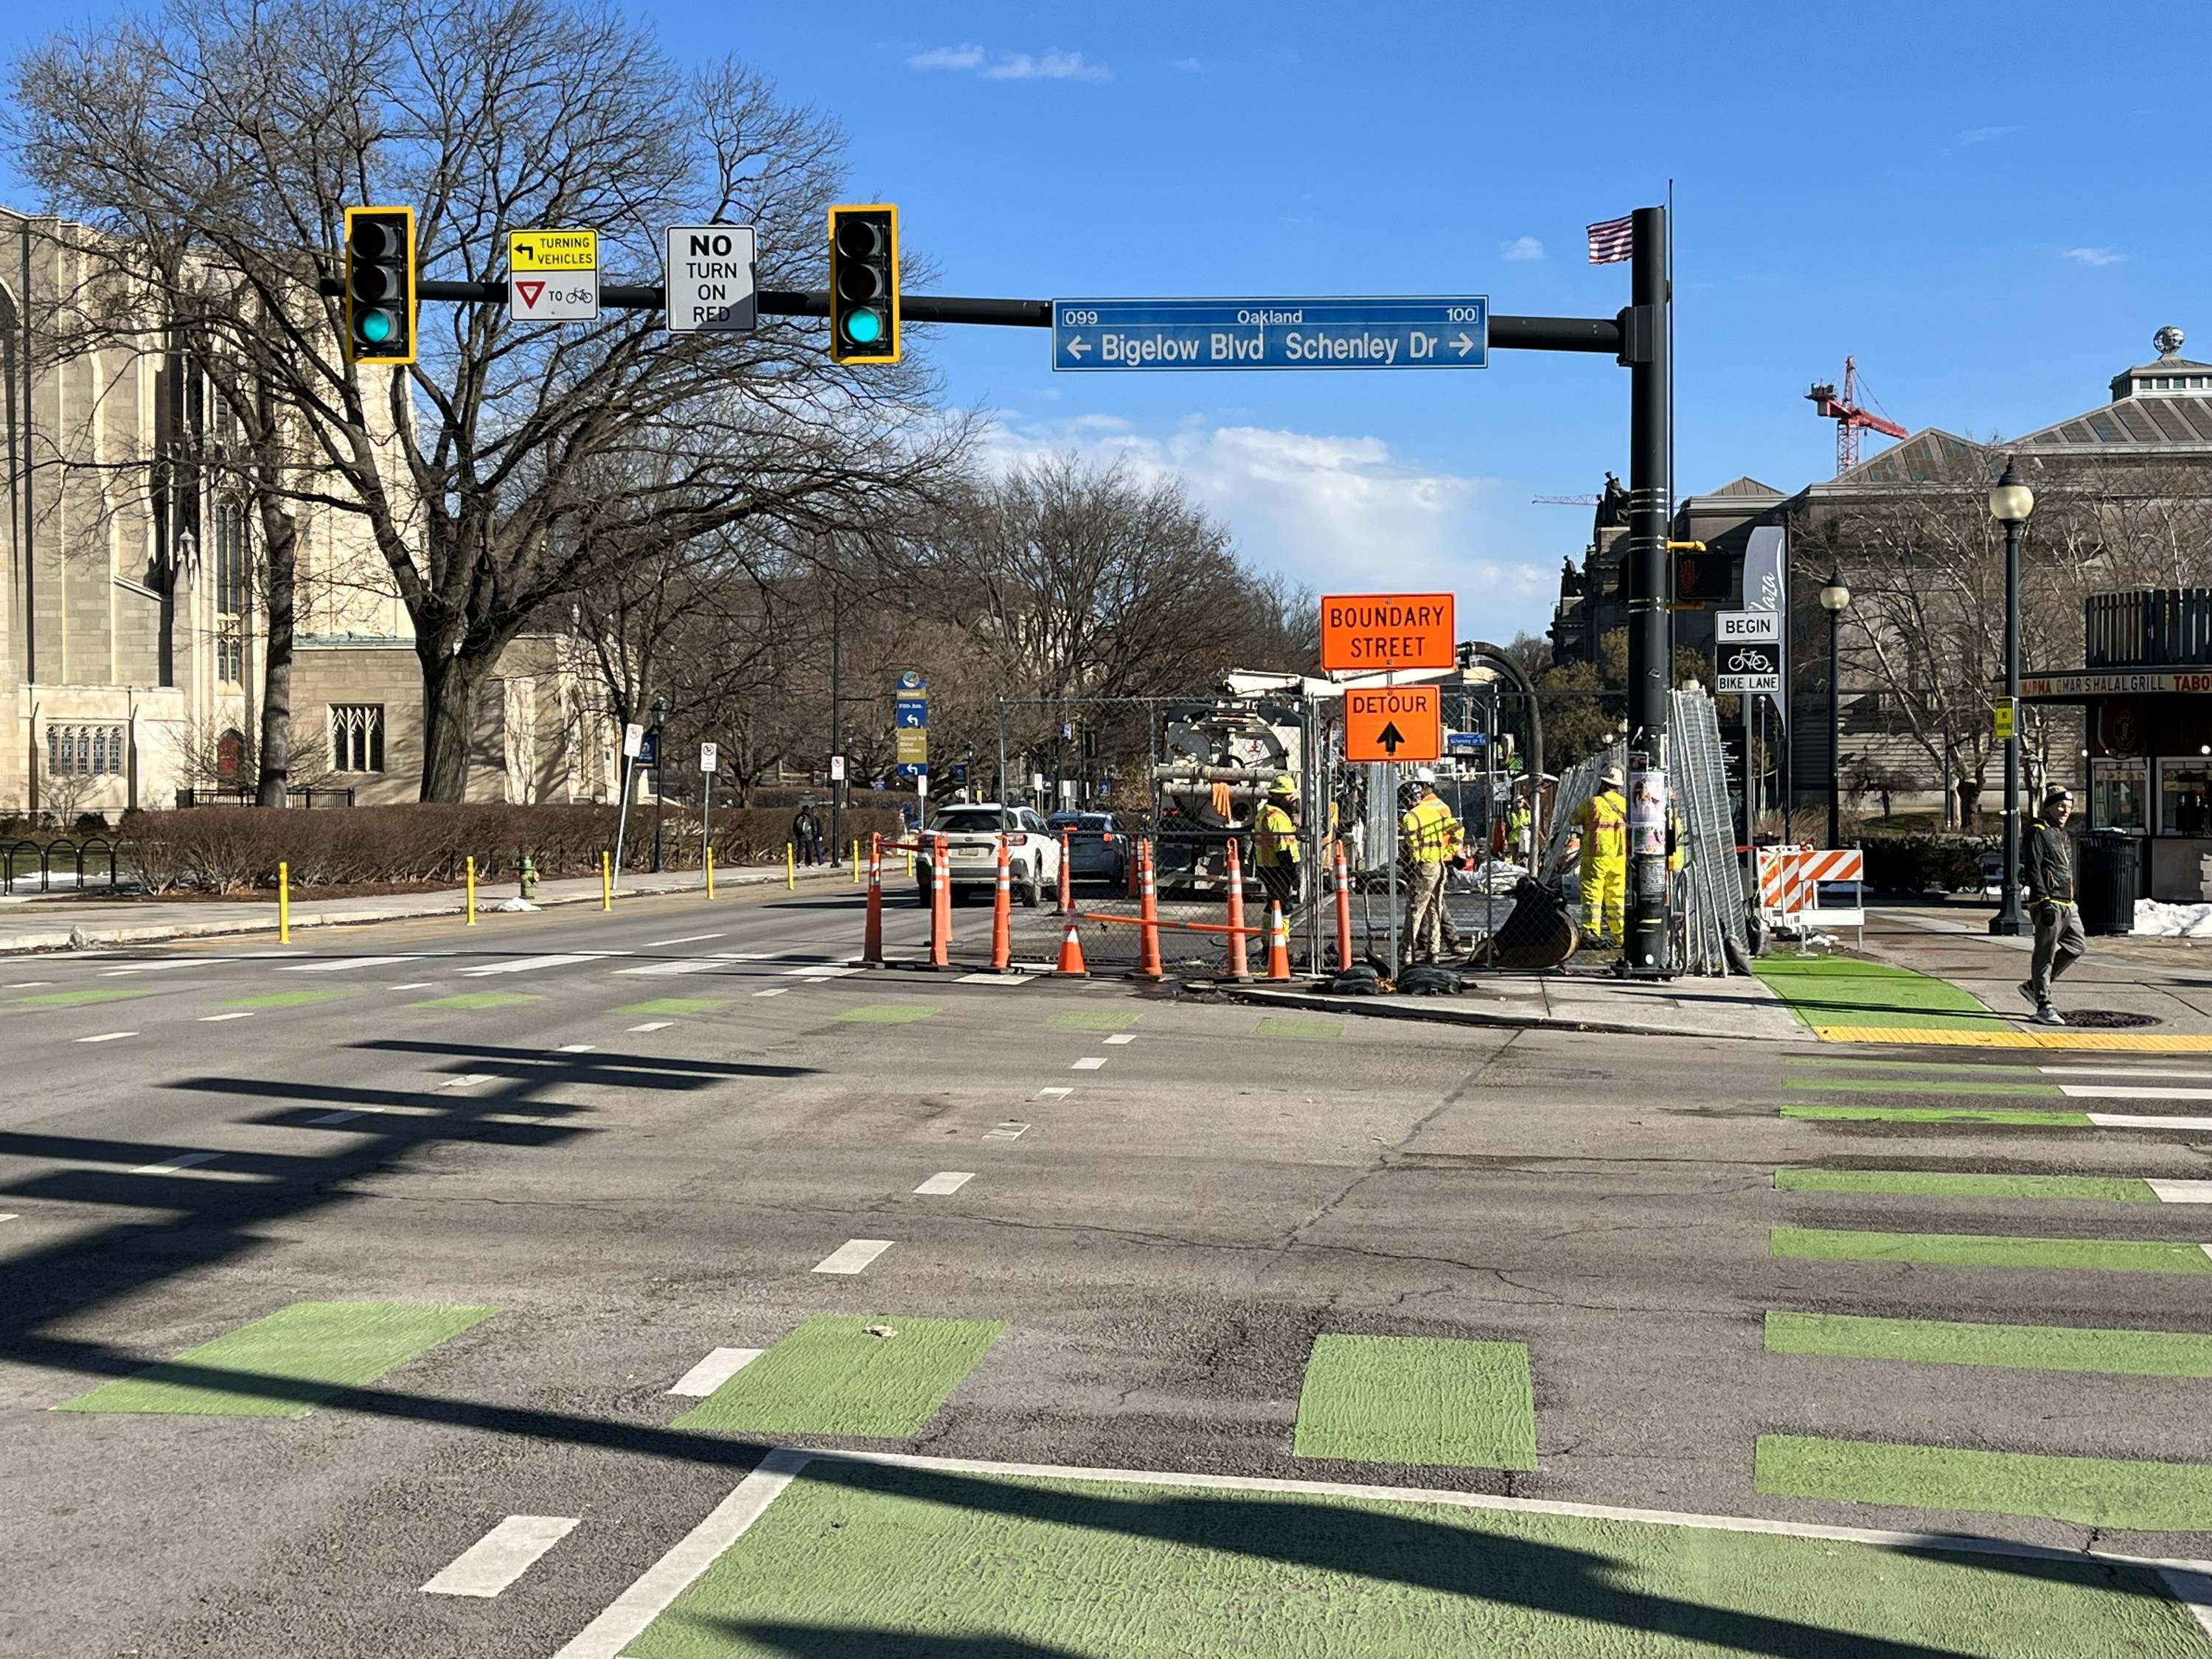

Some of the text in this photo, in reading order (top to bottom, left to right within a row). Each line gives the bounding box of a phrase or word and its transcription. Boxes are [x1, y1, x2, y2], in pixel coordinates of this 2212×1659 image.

[540, 237, 590, 248] TURNING
[689, 234, 732, 257] NO
[538, 253, 593, 265] VEHICLES
[686, 262, 737, 279] TURN
[549, 291, 563, 302] TO
[698, 284, 726, 301] ON
[692, 306, 731, 322] RED
[1065, 310, 1098, 325] 099
[1237, 309, 1303, 324] Oakland
[1446, 307, 1475, 322] 100
[1102, 333, 1263, 366] Bigelow Blvd
[1285, 331, 1438, 364] Schenley Dr
[1748, 571, 1778, 611] laza
[1330, 606, 1445, 627] BOUNDARY
[1725, 619, 1771, 633] BEGIN
[1350, 637, 1426, 658] STREET
[1719, 677, 1777, 689] BIKE LANE
[2056, 678, 2090, 693] OMAR'S
[2093, 676, 2127, 692] HALAL
[2131, 675, 2166, 691] GRILL
[2173, 675, 2212, 692] TABO
[1352, 696, 1427, 714] DETOUR
